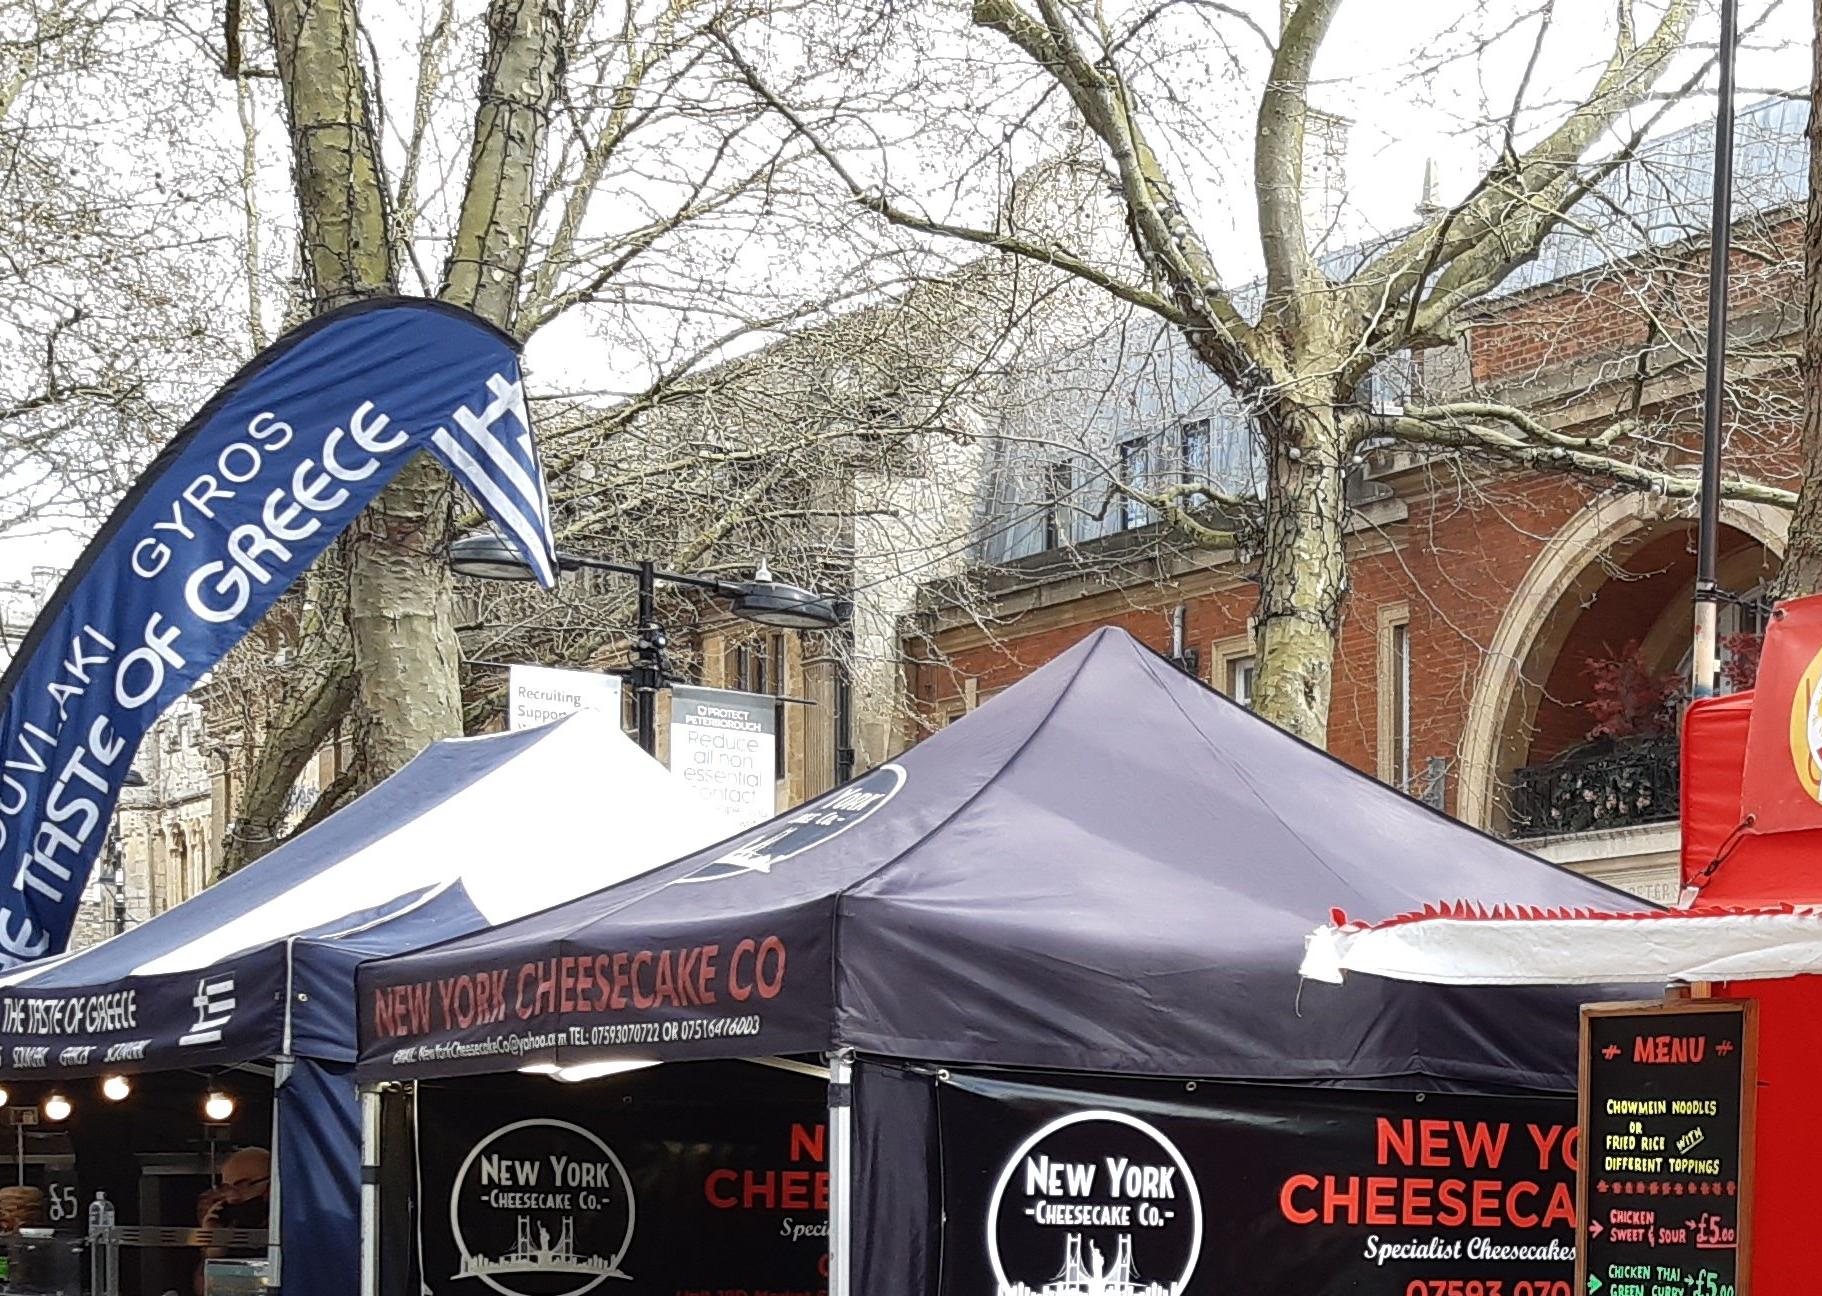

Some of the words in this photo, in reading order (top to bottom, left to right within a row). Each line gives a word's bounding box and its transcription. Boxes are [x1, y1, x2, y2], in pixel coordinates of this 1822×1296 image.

[132, 411, 293, 579] GYROS
[14, 715, 125, 902] TASTE
[115, 612, 185, 709] OF
[184, 400, 408, 622] GREECE
[518, 686, 582, 708] Recruiting
[685, 714, 762, 732] PETERBOROUGH
[707, 708, 750, 720] PROTECT
[688, 730, 759, 752] Reduce
[684, 767, 762, 787] essential
[375, 981, 432, 1038] NEW
[438, 969, 508, 1027] YORK
[515, 945, 719, 1020] CHEESECAKE
[729, 935, 786, 1000] CO
[2, 997, 26, 1034] THE
[27, 998, 65, 1034] TASTE
[64, 996, 86, 1034] OF
[86, 989, 137, 1034] GREECE
[569, 1026, 589, 1045] TEL:
[592, 1022, 659, 1045] 07593070722
[663, 1021, 679, 1042] OR
[1633, 1036, 1706, 1063] MENU
[1606, 1099, 1666, 1115] CHOWMEIN
[1672, 1101, 1716, 1116] NOODLES
[1606, 1136, 1636, 1150] FRIED
[1641, 1137, 1665, 1151] RICE
[1676, 1126, 1704, 1152] WITH
[1629, 1121, 1643, 1135] OR
[1377, 1117, 1510, 1170] NEW
[481, 1152, 540, 1188] NEW
[550, 1155, 610, 1190] YORK
[1026, 1155, 1096, 1198] NEW
[1106, 1157, 1176, 1199] YORK
[1605, 1157, 1663, 1173] DIFFERENT
[1669, 1159, 1720, 1175] TOPPINGS
[50, 1183, 78, 1222] £5
[1279, 1174, 1577, 1228] CHEESECA
[1609, 1209, 1655, 1225] CHICKEN
[1609, 1228, 1645, 1242] SWEET
[1658, 1228, 1687, 1244] SOUR
[1696, 1213, 1735, 1243] £5.00
[1363, 1234, 1462, 1266] Specialist
[1467, 1236, 1577, 1261] Cheesecakes
[1608, 1264, 1650, 1280] CHICKEN
[1656, 1266, 1681, 1282] THAI
